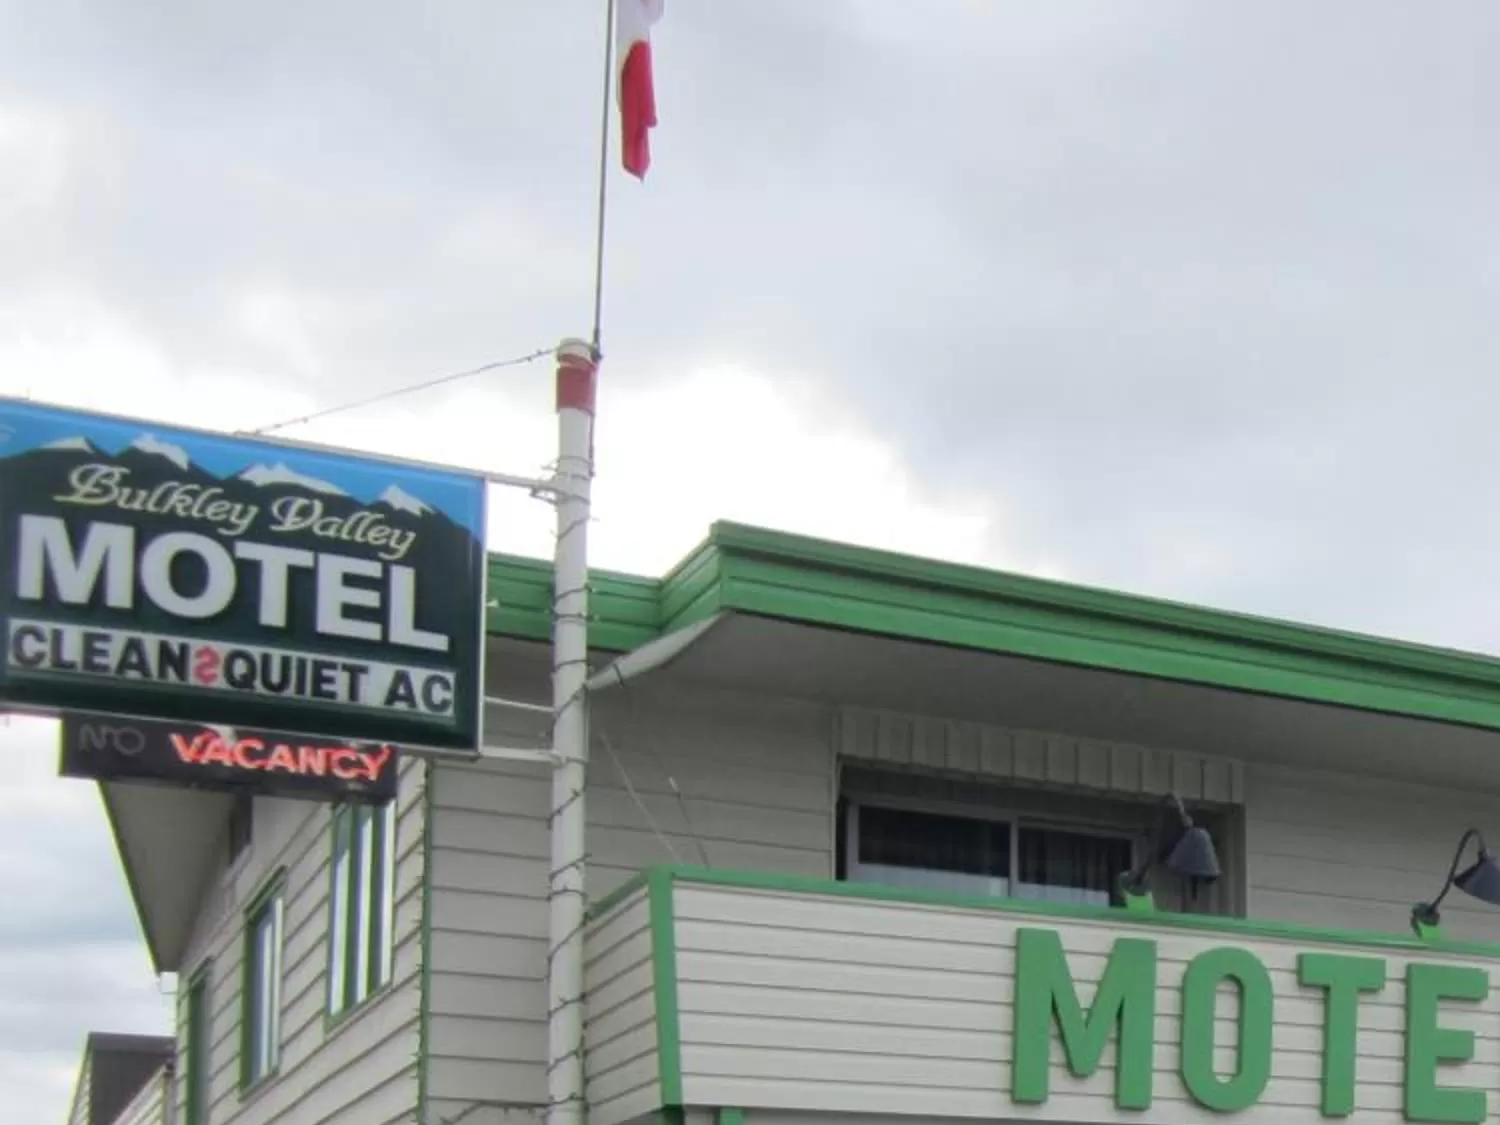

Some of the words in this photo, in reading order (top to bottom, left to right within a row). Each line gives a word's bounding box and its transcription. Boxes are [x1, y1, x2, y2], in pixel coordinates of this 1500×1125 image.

[53, 463, 260, 536] Bulkley
[270, 495, 416, 560] Valley
[16, 513, 450, 652] MOTEL
[11, 624, 192, 683] CLEAN
[223, 648, 369, 702] QUIET
[384, 672, 454, 713] AC
[78, 723, 145, 756] NO
[168, 729, 391, 781] VACANCY
